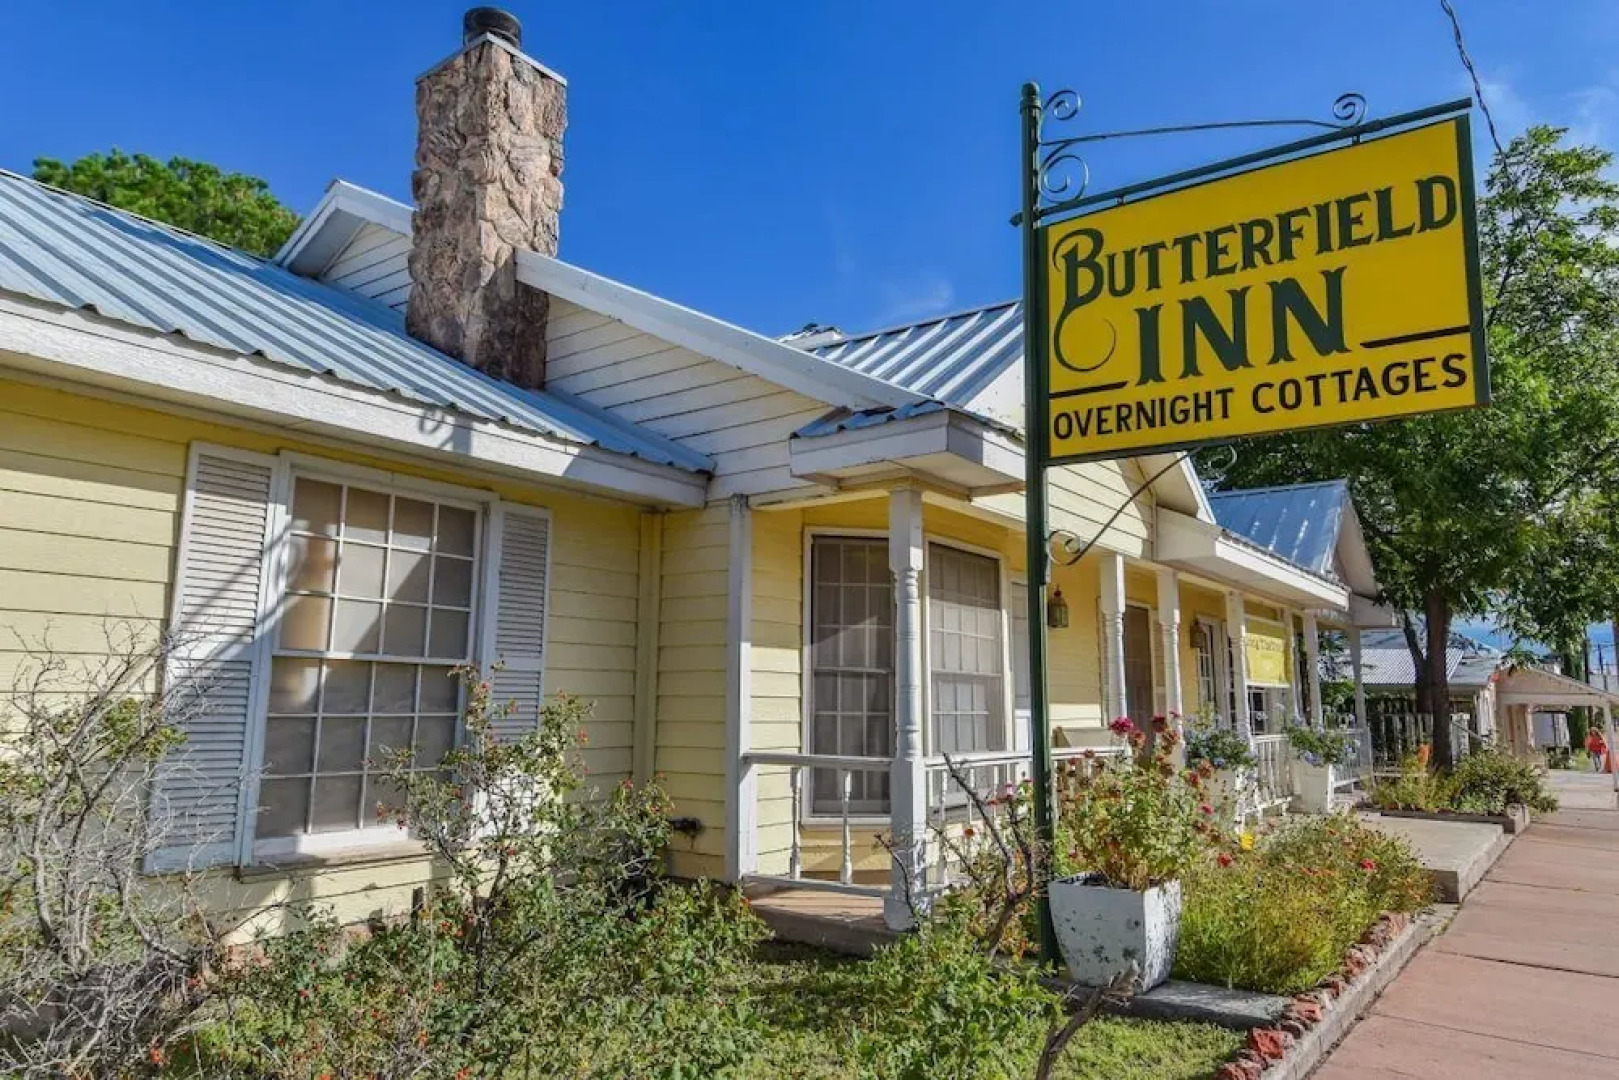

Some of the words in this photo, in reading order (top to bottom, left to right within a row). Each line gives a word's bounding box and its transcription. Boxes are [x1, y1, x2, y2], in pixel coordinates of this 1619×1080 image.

[1053, 175, 1457, 371] BUTTERFIELD
[1134, 266, 1352, 387] INN
[1053, 388, 1234, 440] OVERNIGHT
[1252, 353, 1467, 414] COTTAGES
